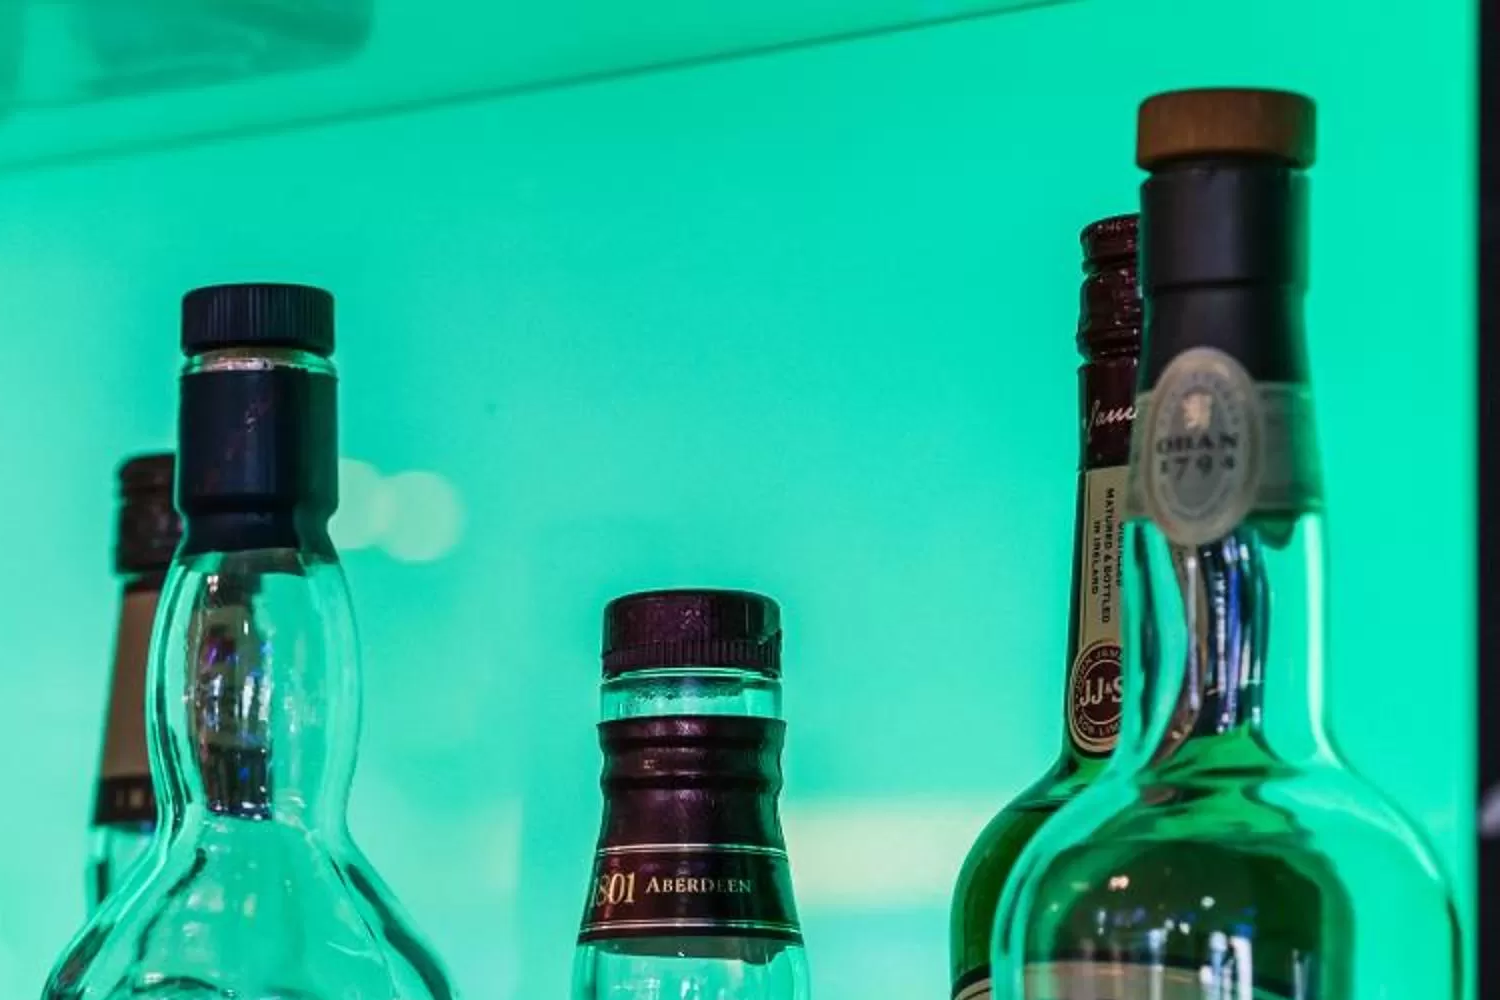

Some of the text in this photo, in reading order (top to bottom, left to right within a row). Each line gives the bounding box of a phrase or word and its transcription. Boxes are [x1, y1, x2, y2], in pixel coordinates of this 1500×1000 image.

[1104, 487, 1116, 549] MATURED
[1091, 536, 1101, 596] IRELAND
[1102, 565, 1113, 624] BOTTLED
[645, 876, 751, 895] ABERDEEN
